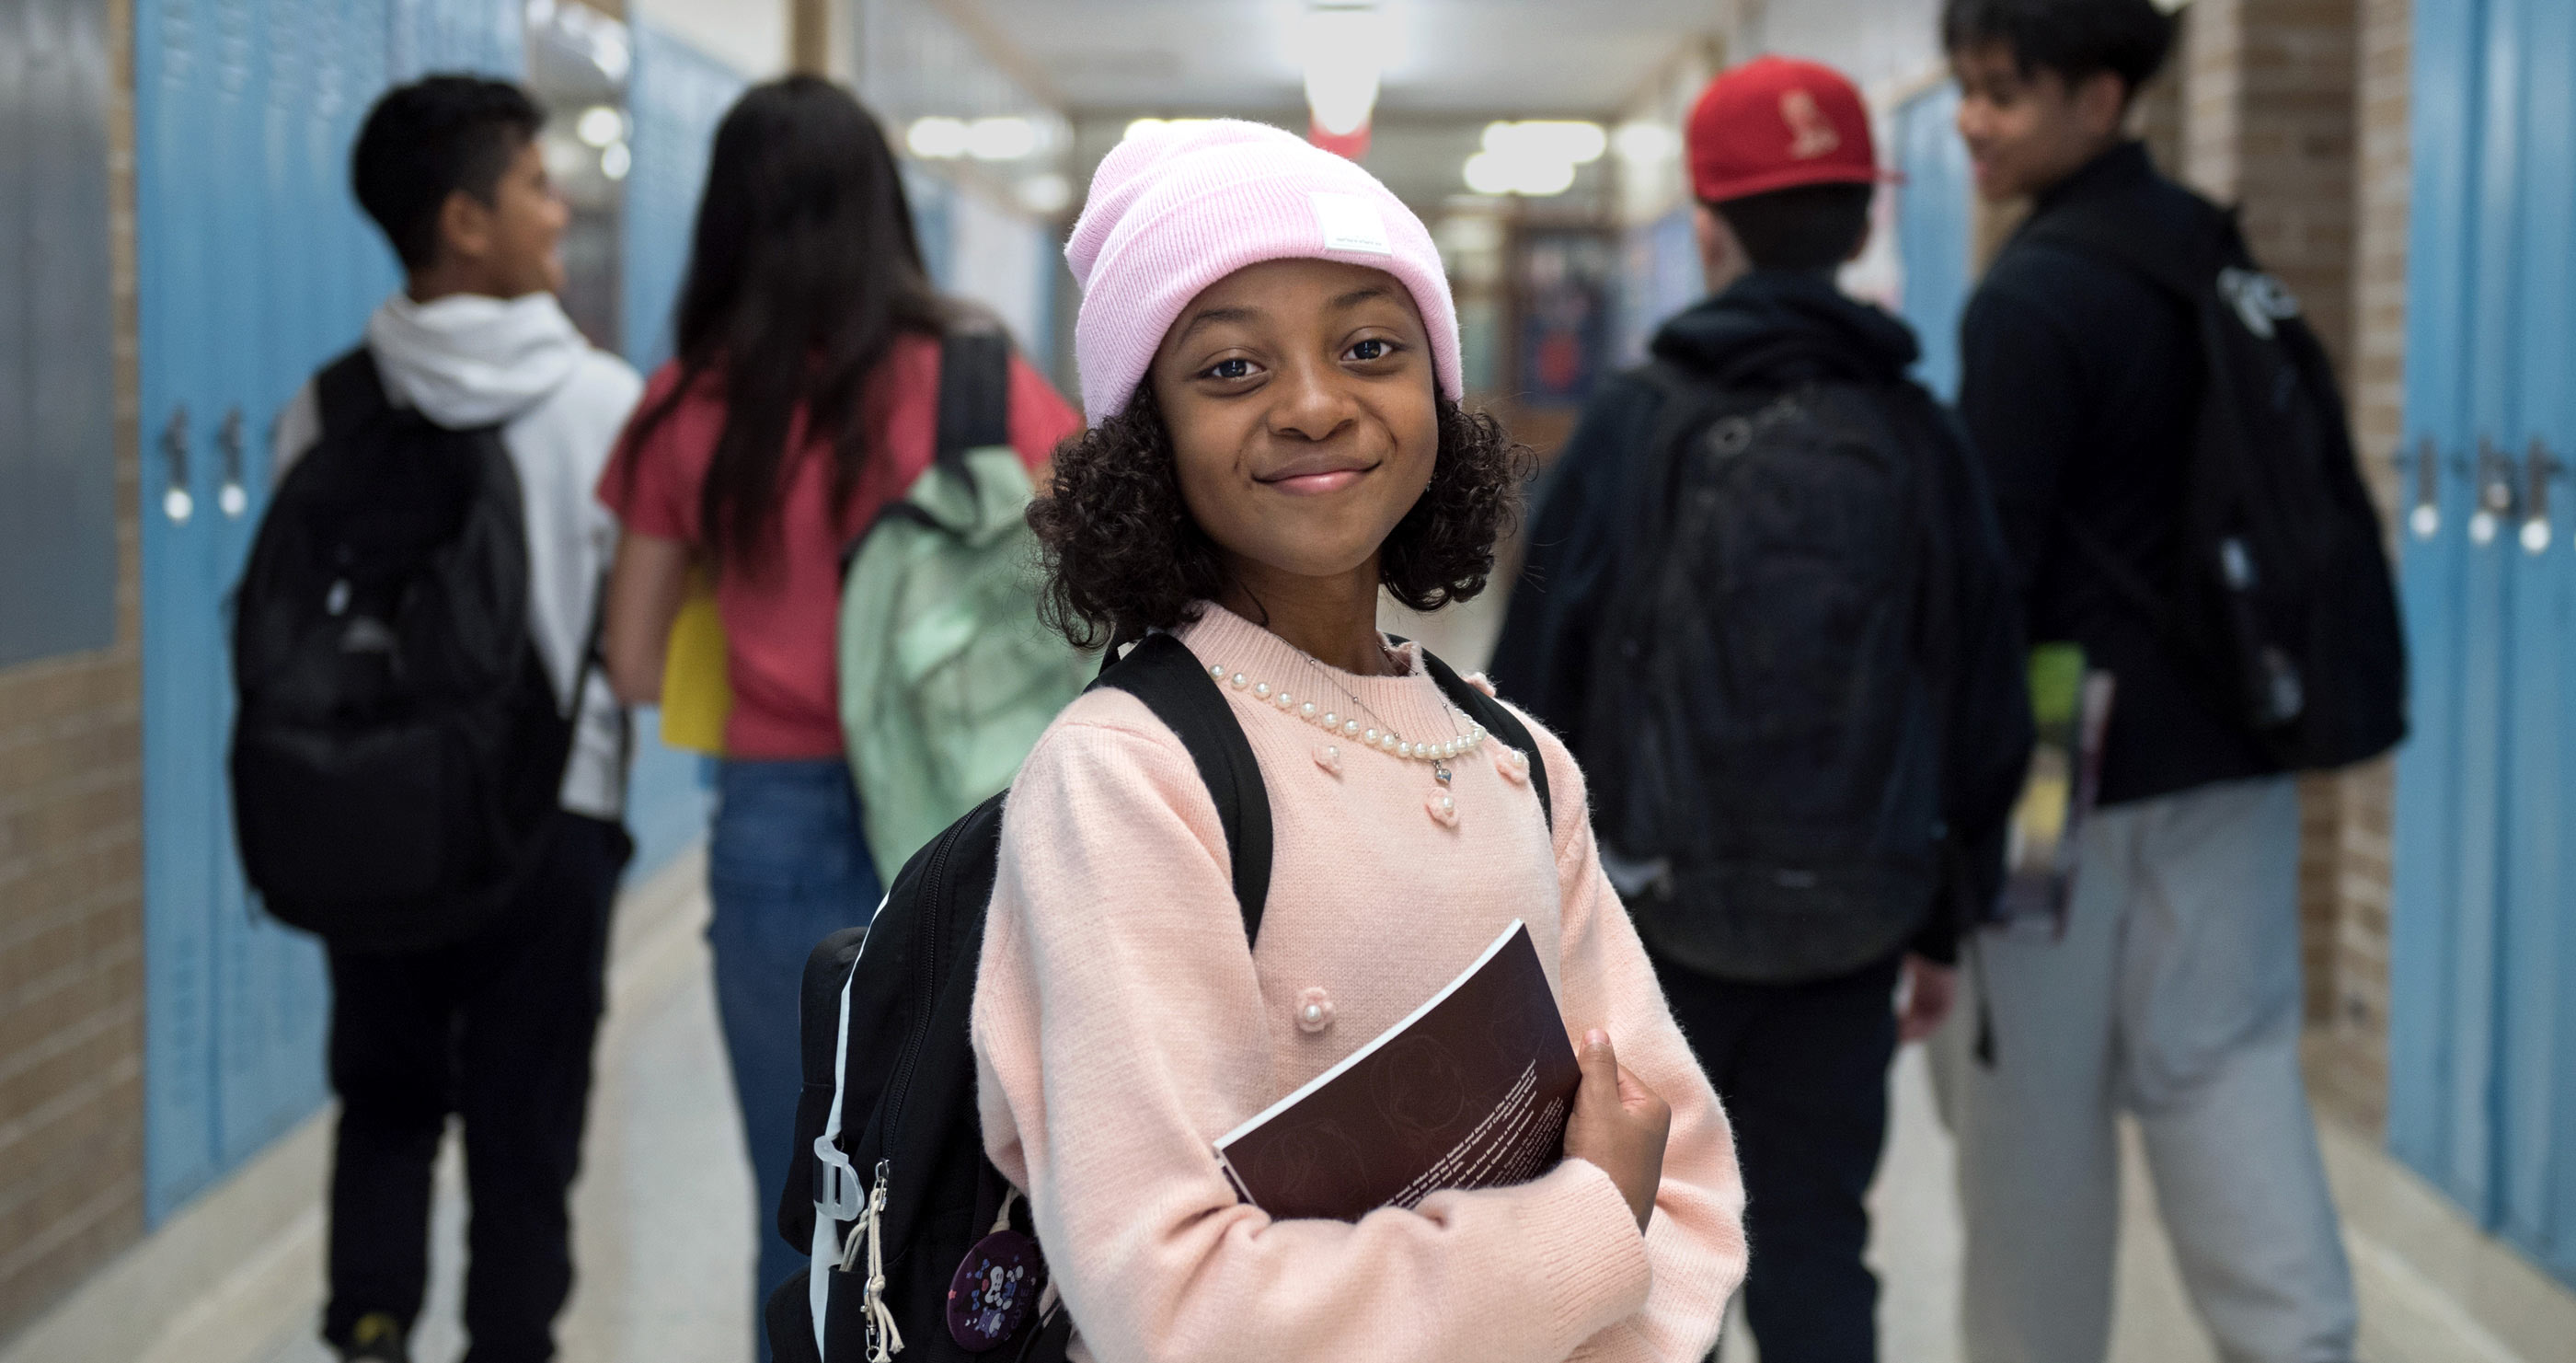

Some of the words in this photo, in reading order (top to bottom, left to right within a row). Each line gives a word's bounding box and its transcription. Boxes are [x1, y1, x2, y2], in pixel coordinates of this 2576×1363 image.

[1420, 1182, 1429, 1191] up
[1428, 1172, 1440, 1184] with
[1439, 1163, 1449, 1174] the
[1449, 1143, 1472, 1166] historical
[1471, 1128, 1487, 1146] legacy
[1487, 1121, 1493, 1130] of
[1492, 1102, 1512, 1124] Canada's
[1529, 1068, 1535, 1078] of
[1507, 1130, 1520, 1147] Novel
[1395, 1184, 1412, 1199] novel,
[1412, 1171, 1429, 1186] debut
[1429, 1157, 1446, 1173] author
[1465, 1131, 1475, 1144] and
[1442, 1169, 1453, 1182] and
[1453, 1161, 1466, 1173] girls.
[1458, 1173, 1466, 1183] for
[1466, 1162, 1478, 1175] Best
[1477, 1153, 1487, 1165] First
[1486, 1141, 1499, 1155] Book
[1498, 1134, 1505, 1142] by
